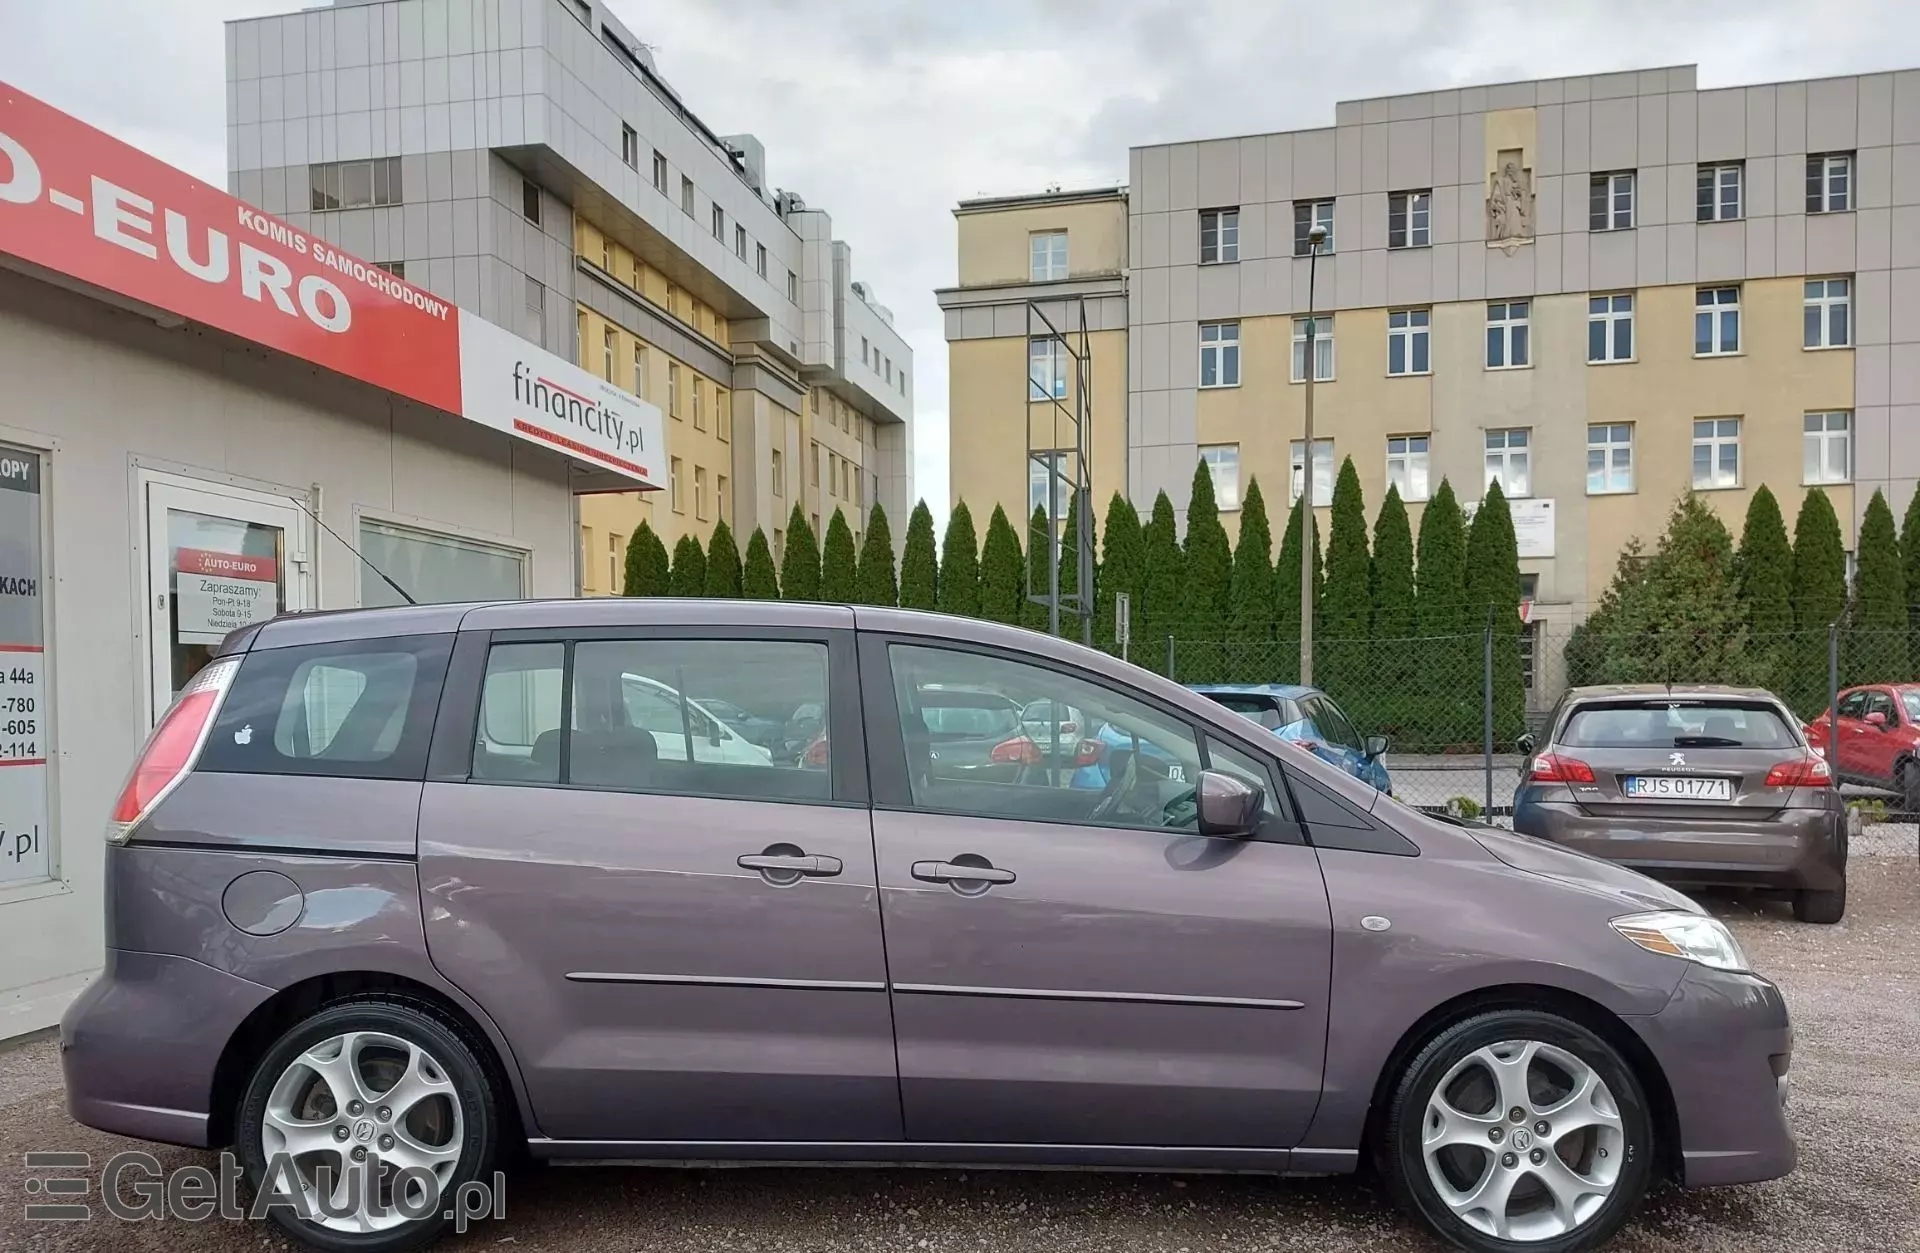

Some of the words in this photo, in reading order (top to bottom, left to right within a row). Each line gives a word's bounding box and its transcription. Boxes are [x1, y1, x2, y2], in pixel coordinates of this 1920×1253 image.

[237, 206, 307, 254] KOMIS
[312, 243, 449, 321] SAMOCHODOWY
[512, 361, 644, 454] financity.pl
[0, 458, 29, 481] OPY
[204, 558, 257, 573] AUTO-EURO
[200, 579, 261, 599] Zapraszamy:
[212, 607, 236, 618] Sobota
[207, 618, 237, 629] Niedziela
[10, 667, 34, 684] 44a
[1636, 778, 1669, 794] RJS
[1675, 779, 1725, 795] 01771
